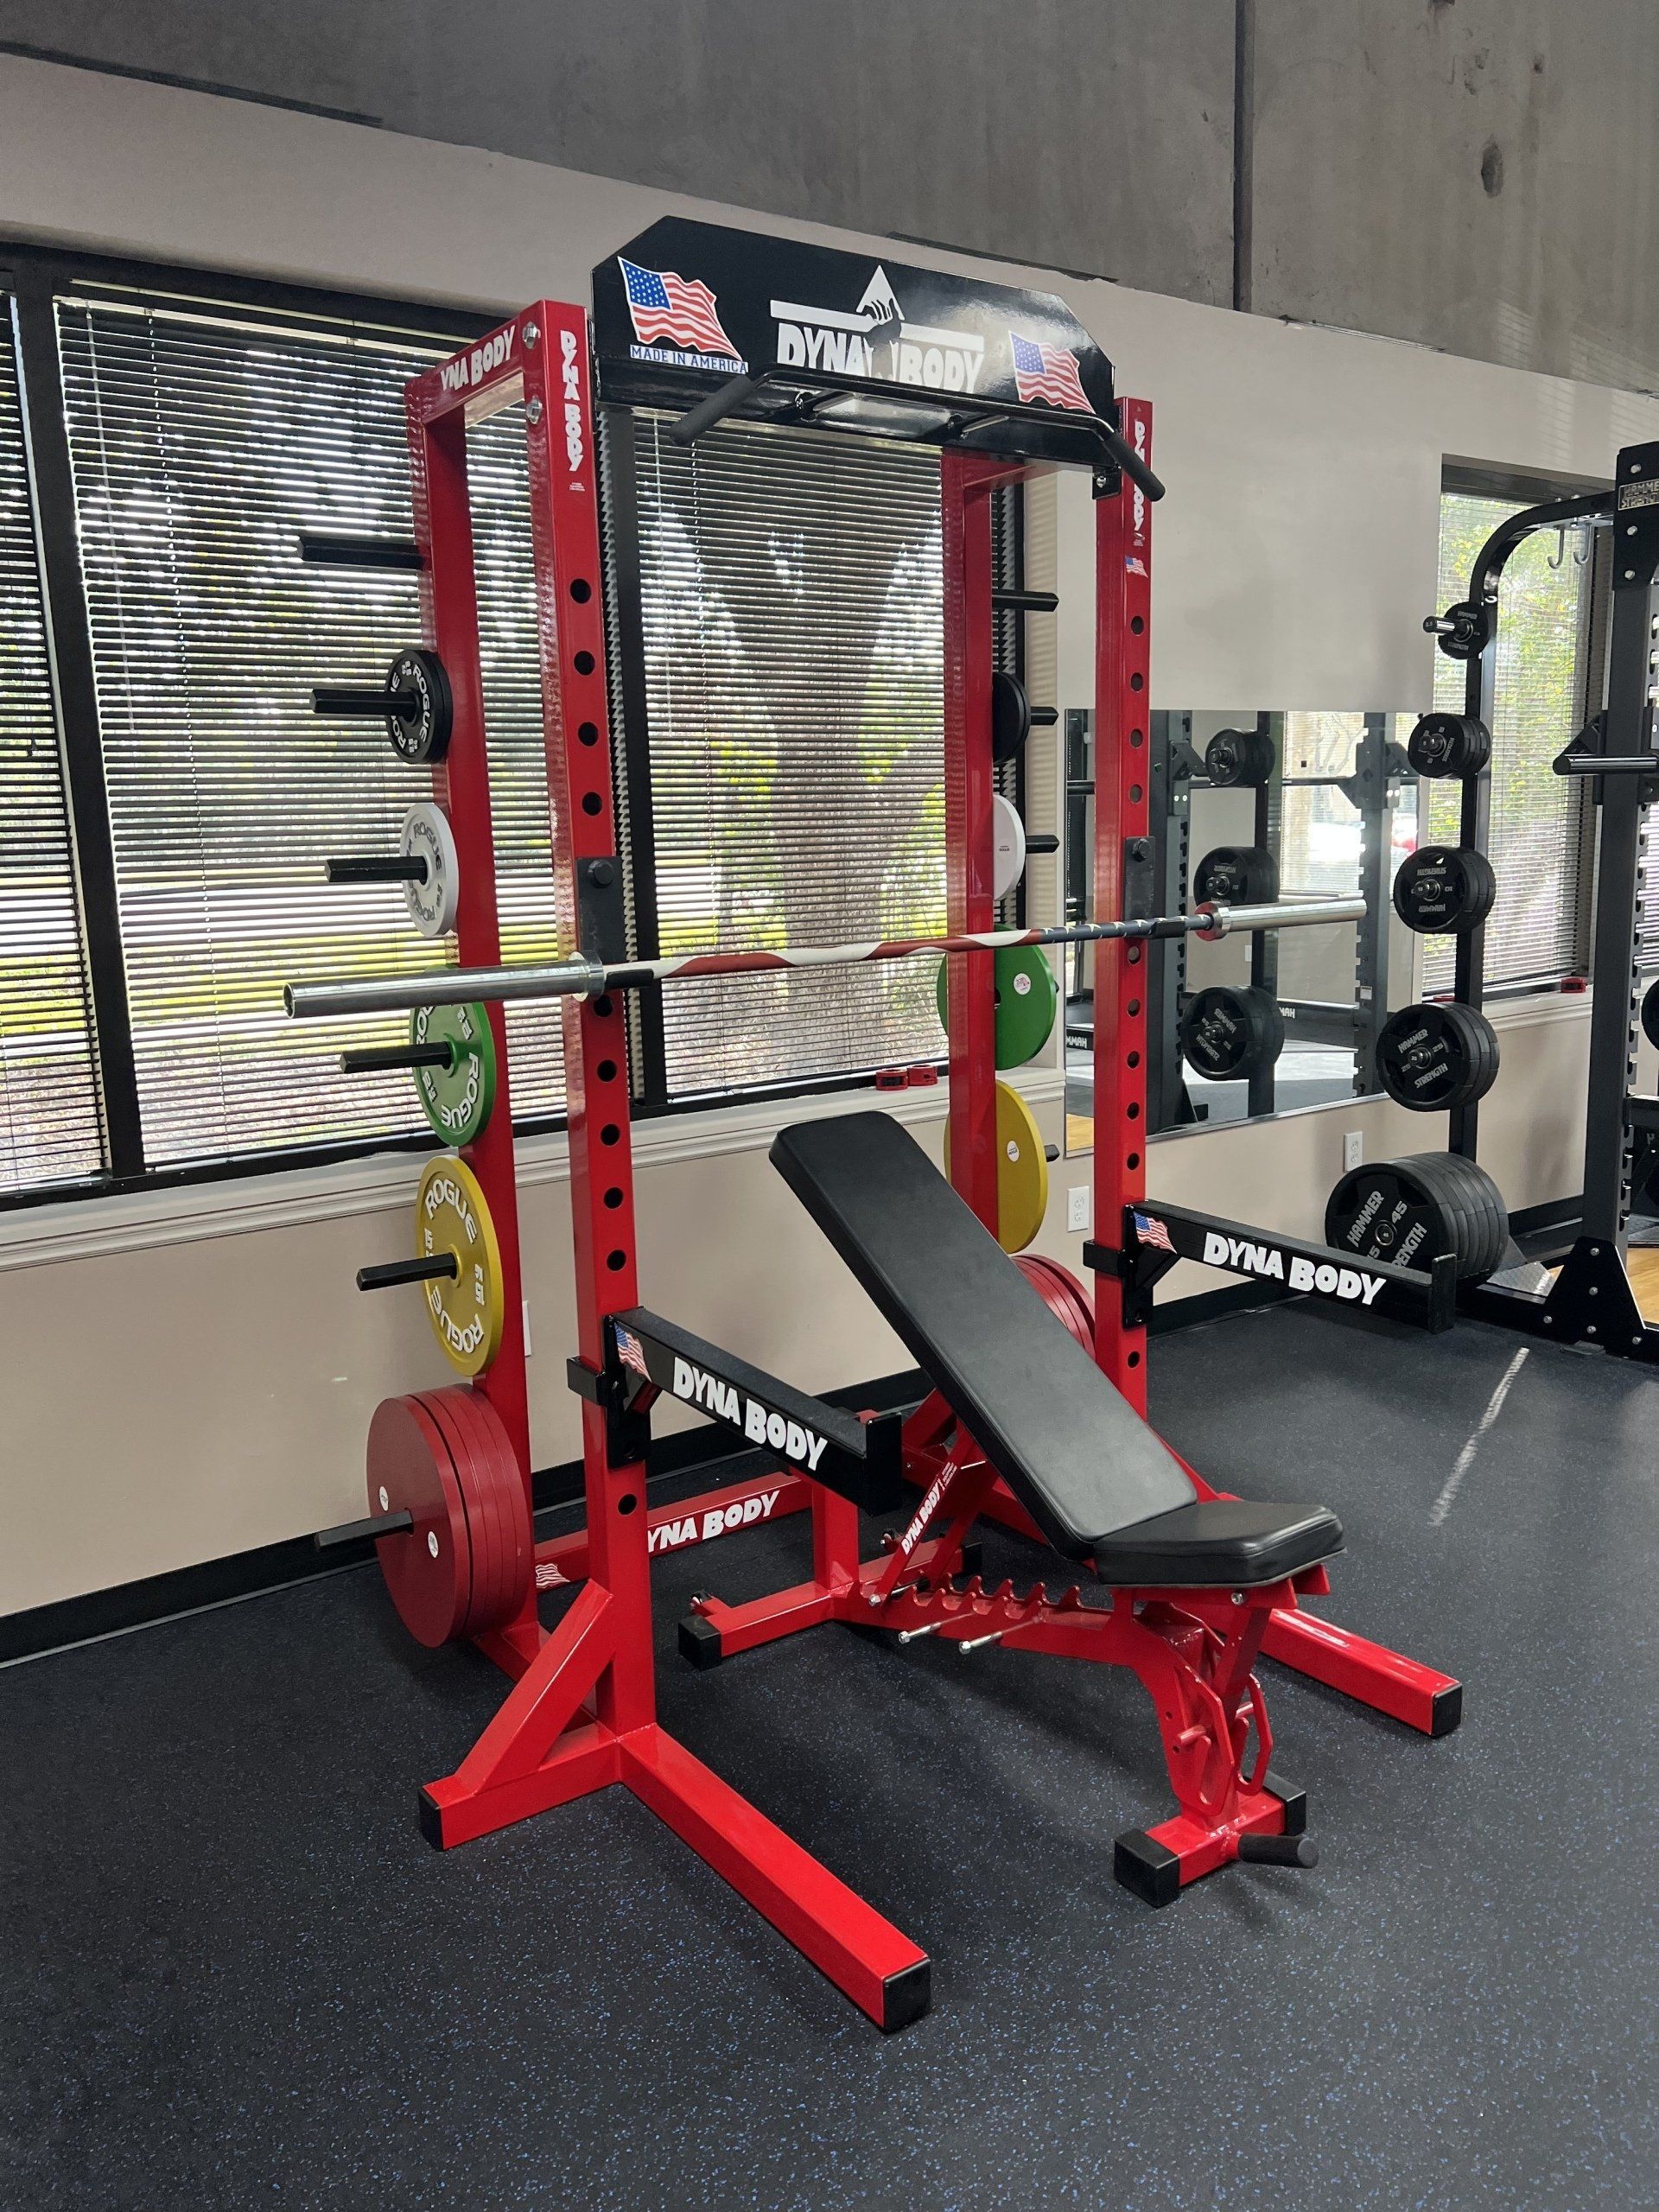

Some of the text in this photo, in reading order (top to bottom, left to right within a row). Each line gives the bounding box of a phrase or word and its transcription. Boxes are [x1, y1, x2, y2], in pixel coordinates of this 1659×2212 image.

[440, 325, 516, 391] YNA BODY
[560, 329, 581, 401] DYNA
[631, 346, 748, 373] MADE IN AMERICA
[778, 323, 985, 394] DYNA BODY
[564, 403, 584, 472] BODY
[390, 671, 407, 749] ROE
[413, 664, 430, 742] ROGUE
[413, 821, 442, 871] ROGUE
[1397, 1028, 1429, 1054] HAMMER
[441, 1052, 479, 1129] ROGUE
[1414, 1062, 1449, 1089] STRENGTH
[424, 1179, 478, 1244] ROGUE
[1346, 1191, 1385, 1248] HAMMER
[1391, 1200, 1408, 1224] 45
[1203, 1231, 1387, 1306] DYNA BODY
[1367, 1244, 1381, 1259] 5
[1391, 1222, 1427, 1268] RENGTH
[431, 1284, 485, 1354] ROGUE
[672, 1356, 829, 1471] DYNA BODY
[647, 1490, 780, 1553] YNA BODY
[901, 1481, 941, 1555] DYNA BODY
